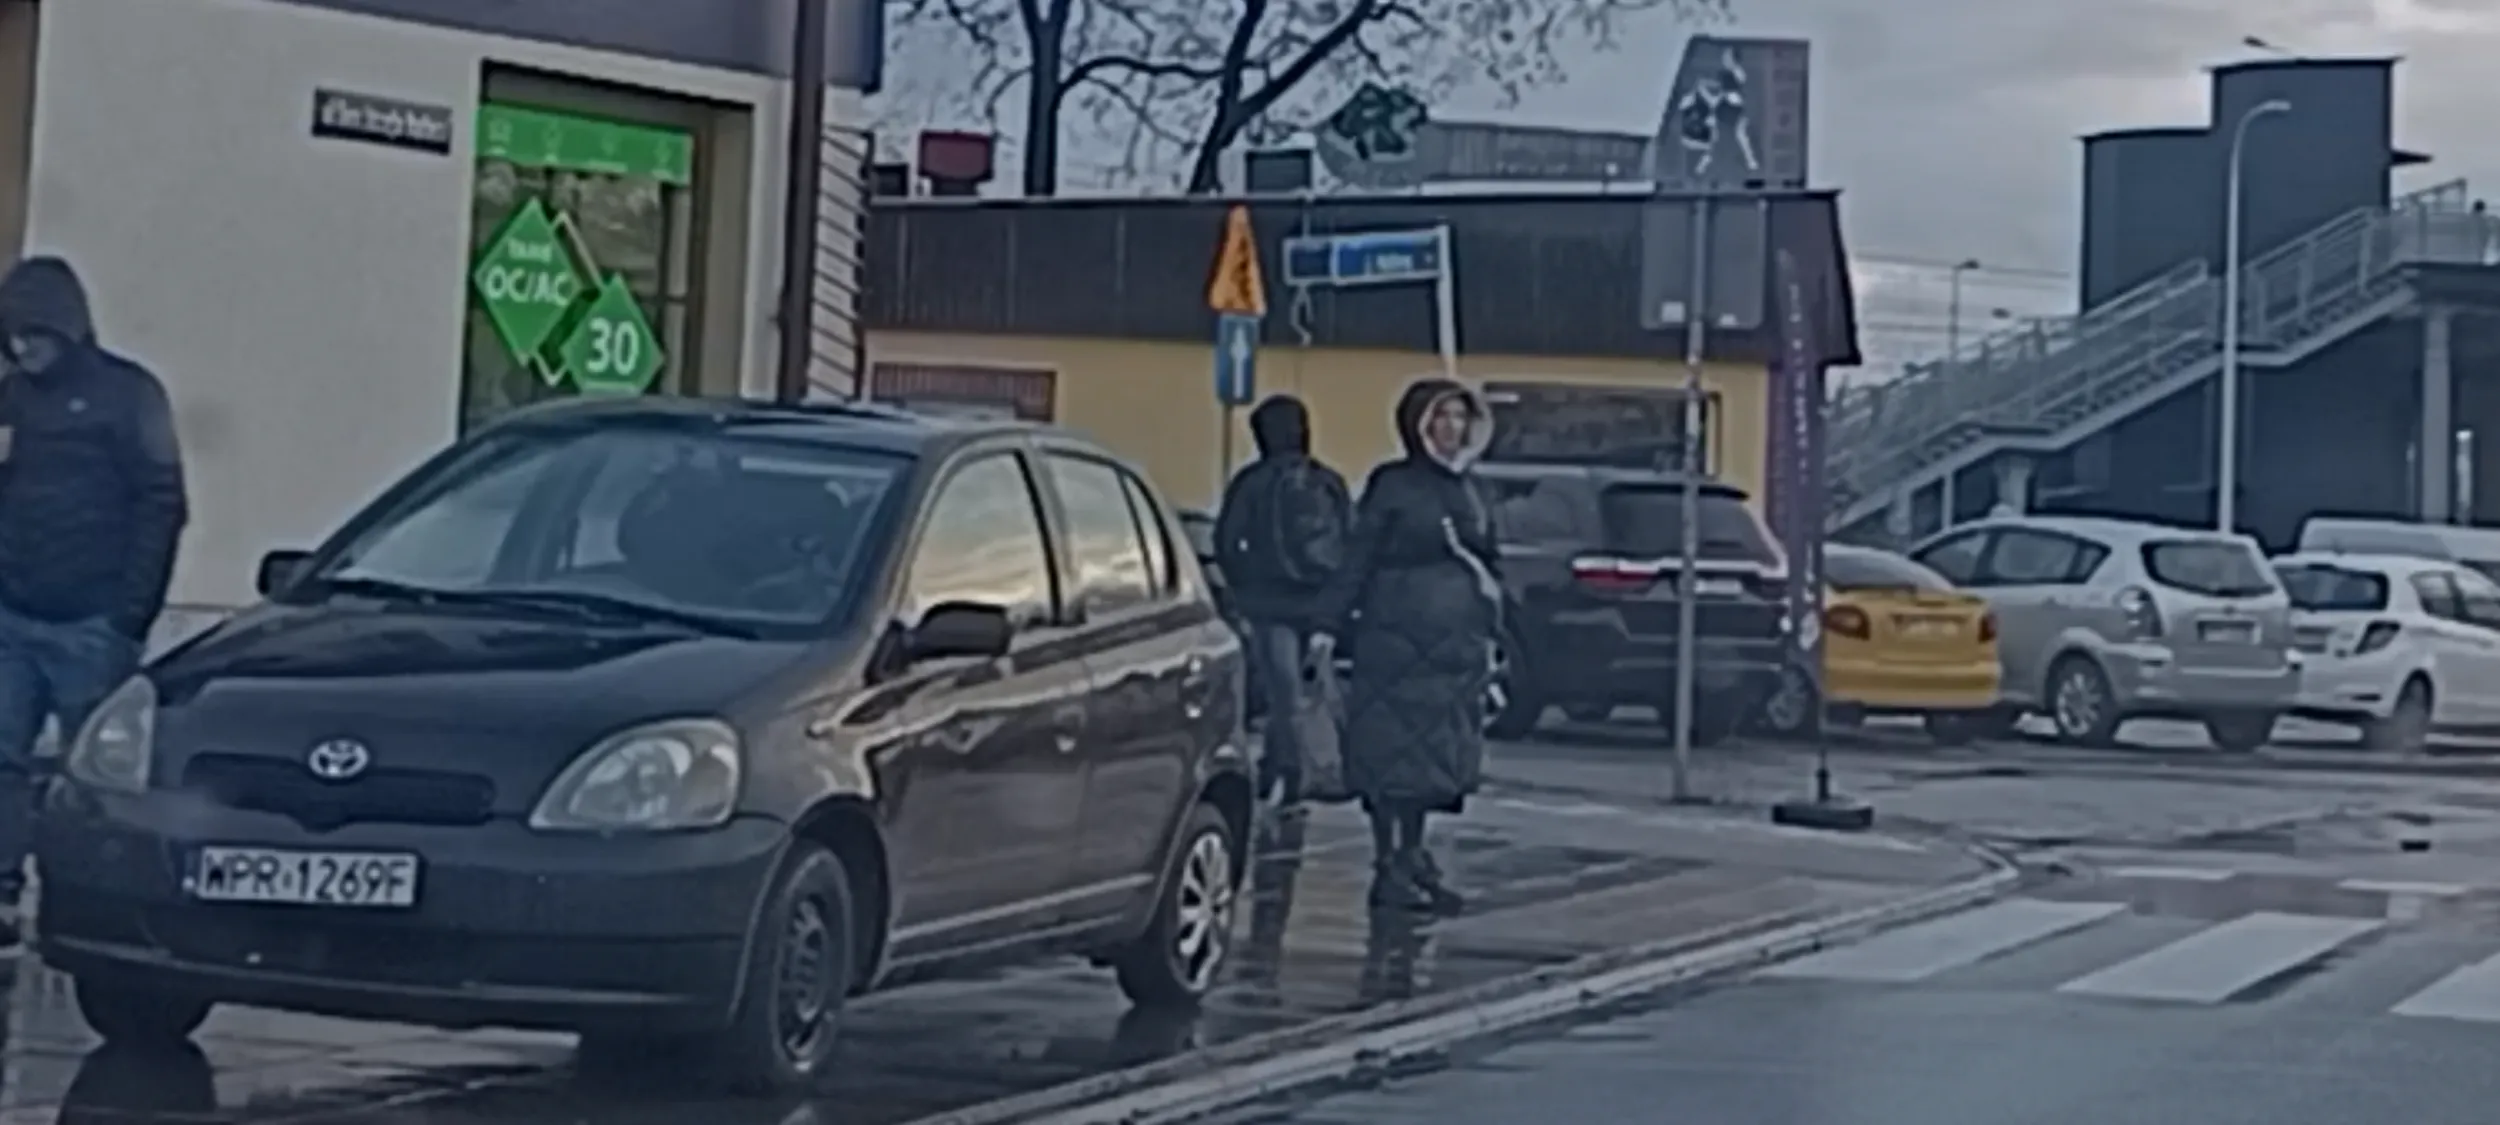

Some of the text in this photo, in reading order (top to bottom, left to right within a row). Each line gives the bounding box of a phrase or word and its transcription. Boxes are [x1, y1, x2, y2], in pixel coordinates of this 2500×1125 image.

[485, 265, 570, 306] OC/AC
[586, 317, 639, 375] 30
[205, 853, 410, 901] WPR 1269F
